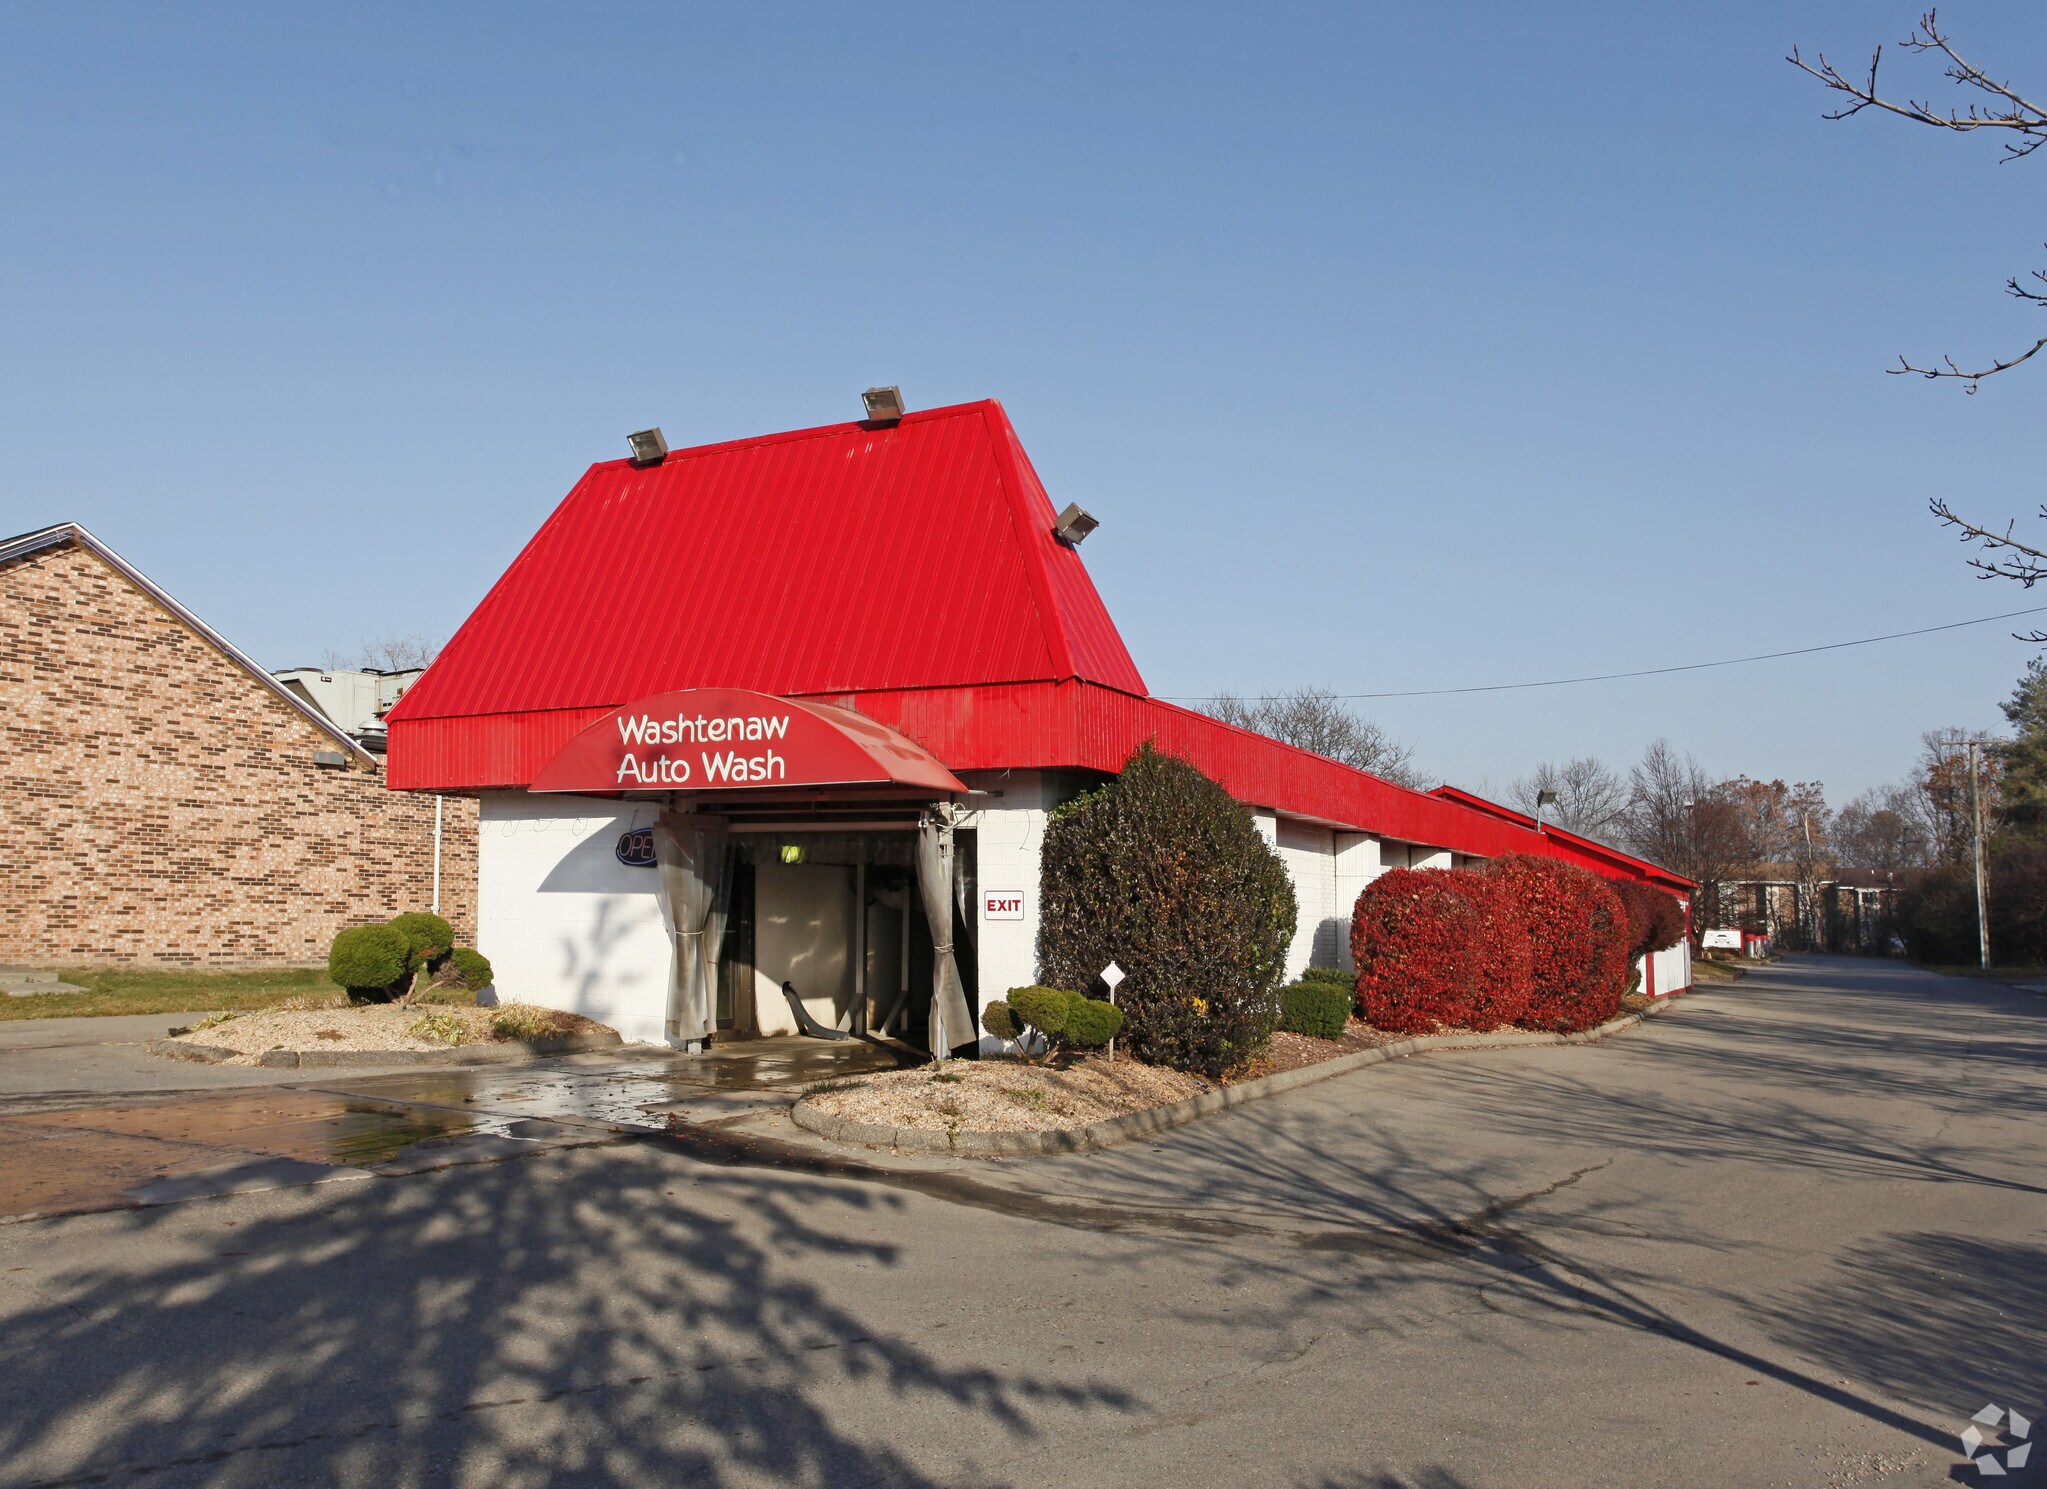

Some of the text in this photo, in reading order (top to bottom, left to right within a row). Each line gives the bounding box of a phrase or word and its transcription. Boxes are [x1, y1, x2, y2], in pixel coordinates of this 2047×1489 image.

[617, 713, 789, 745] Washtenaw
[617, 748, 785, 783] Auto Wash
[987, 899, 1021, 912] EXIT
